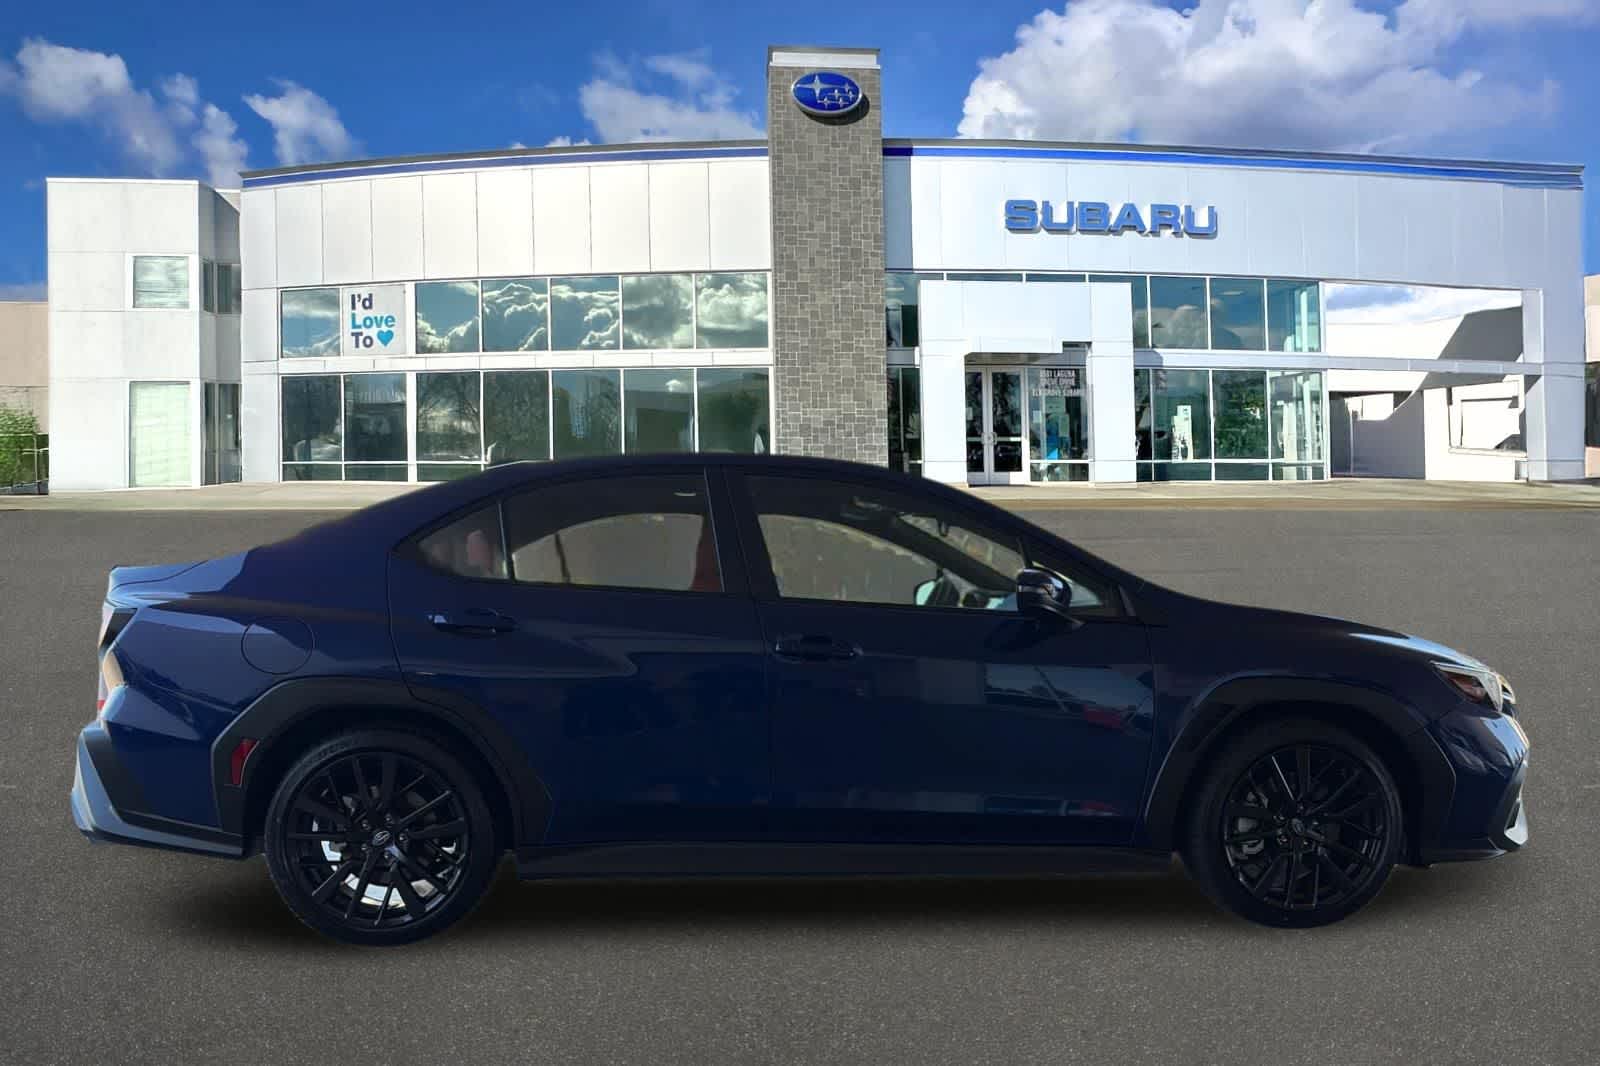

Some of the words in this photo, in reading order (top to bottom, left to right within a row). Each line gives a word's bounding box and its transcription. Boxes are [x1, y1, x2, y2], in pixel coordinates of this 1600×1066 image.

[1005, 200, 1217, 236] SUBARU
[351, 312, 396, 329] Love
[351, 332, 373, 348] To
